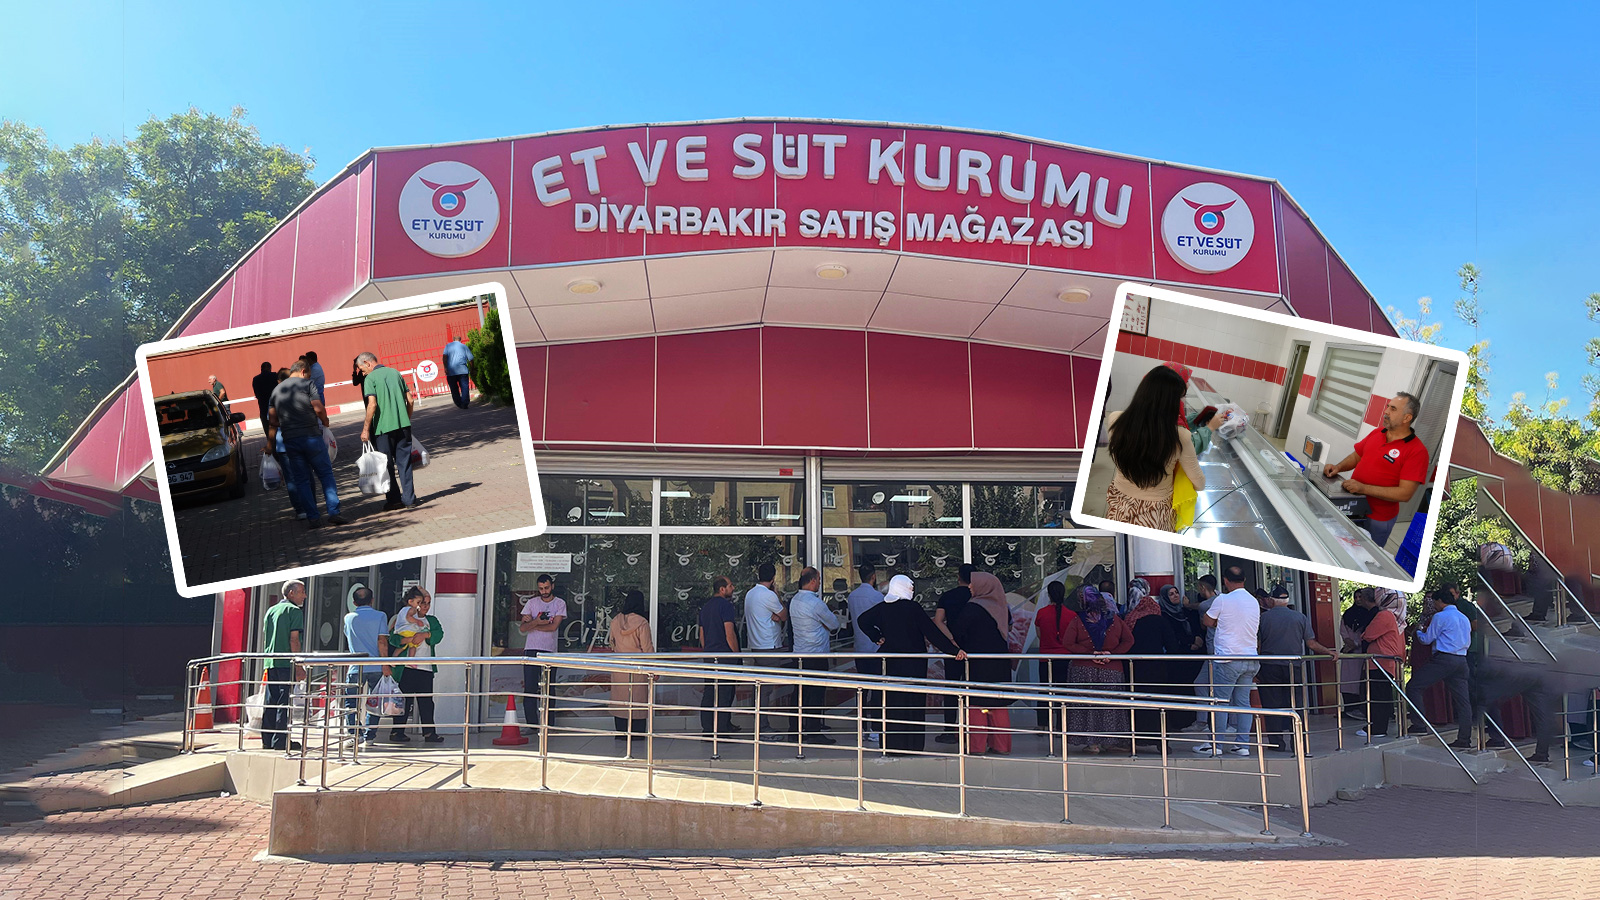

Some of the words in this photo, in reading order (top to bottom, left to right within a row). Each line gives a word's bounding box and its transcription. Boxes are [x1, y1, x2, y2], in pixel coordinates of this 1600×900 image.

[531, 145, 607, 206] ET
[627, 135, 709, 187] VE
[732, 133, 848, 180] SÜT
[868, 138, 1133, 229] KURUMU
[412, 219, 431, 231] ET
[433, 219, 453, 231] VE
[454, 220, 484, 232] SÜT
[574, 197, 787, 237] DİYARBAKIR
[799, 208, 896, 247] SATIŞ
[906, 205, 1094, 249] MAĞAZASI
[428, 232, 466, 240] KURUMU
[1177, 235, 1194, 247] ET
[1196, 236, 1214, 248] VE
[1216, 237, 1243, 250] SÜT
[1192, 248, 1227, 257] KURUMU
[179, 472, 193, 482] 947
